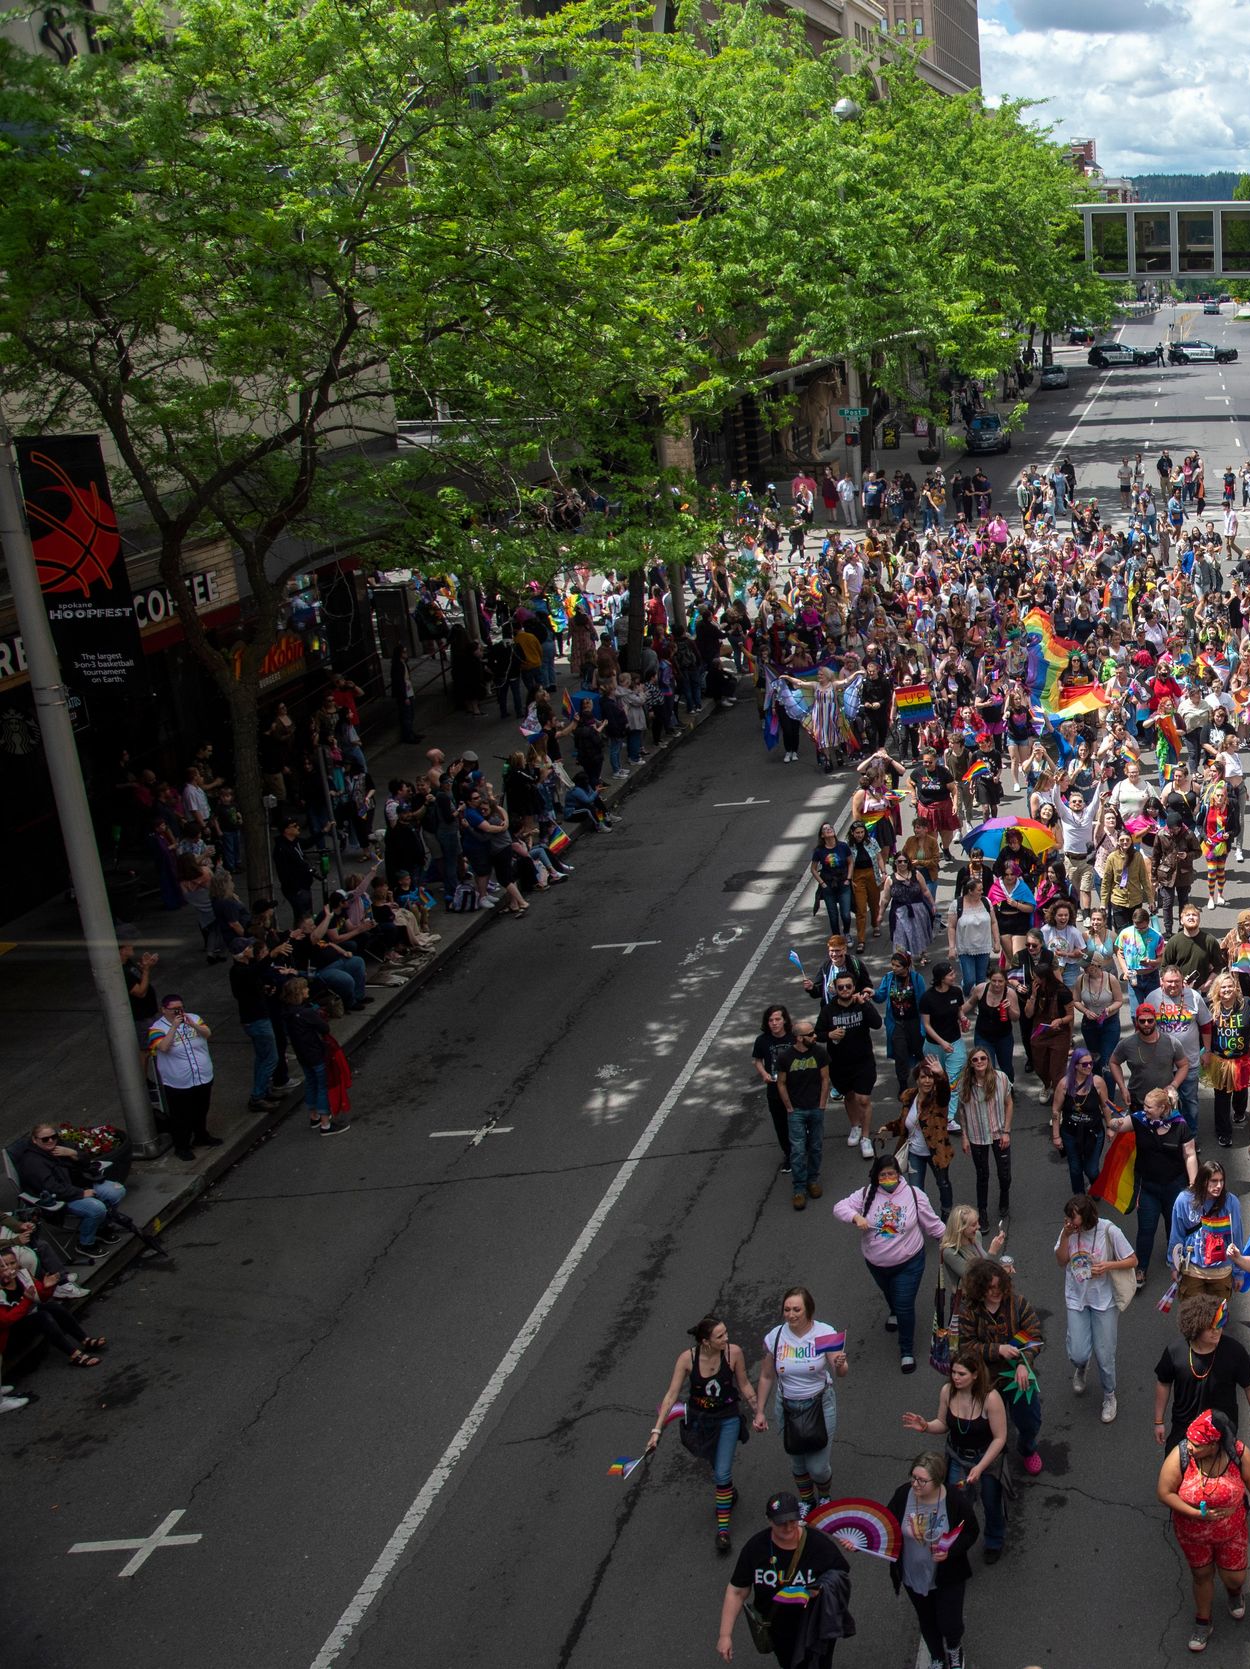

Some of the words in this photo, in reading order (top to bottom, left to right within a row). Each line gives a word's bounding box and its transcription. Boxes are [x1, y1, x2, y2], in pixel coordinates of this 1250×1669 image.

[49, 608, 132, 620] HOOPFEST
[97, 653, 122, 662] largest
[98, 660, 134, 668] basketball
[103, 676, 124, 684] Earth.
[1218, 1014, 1245, 1028] REE
[1217, 1028, 1239, 1036] MOM
[1218, 1036, 1245, 1050] UGS
